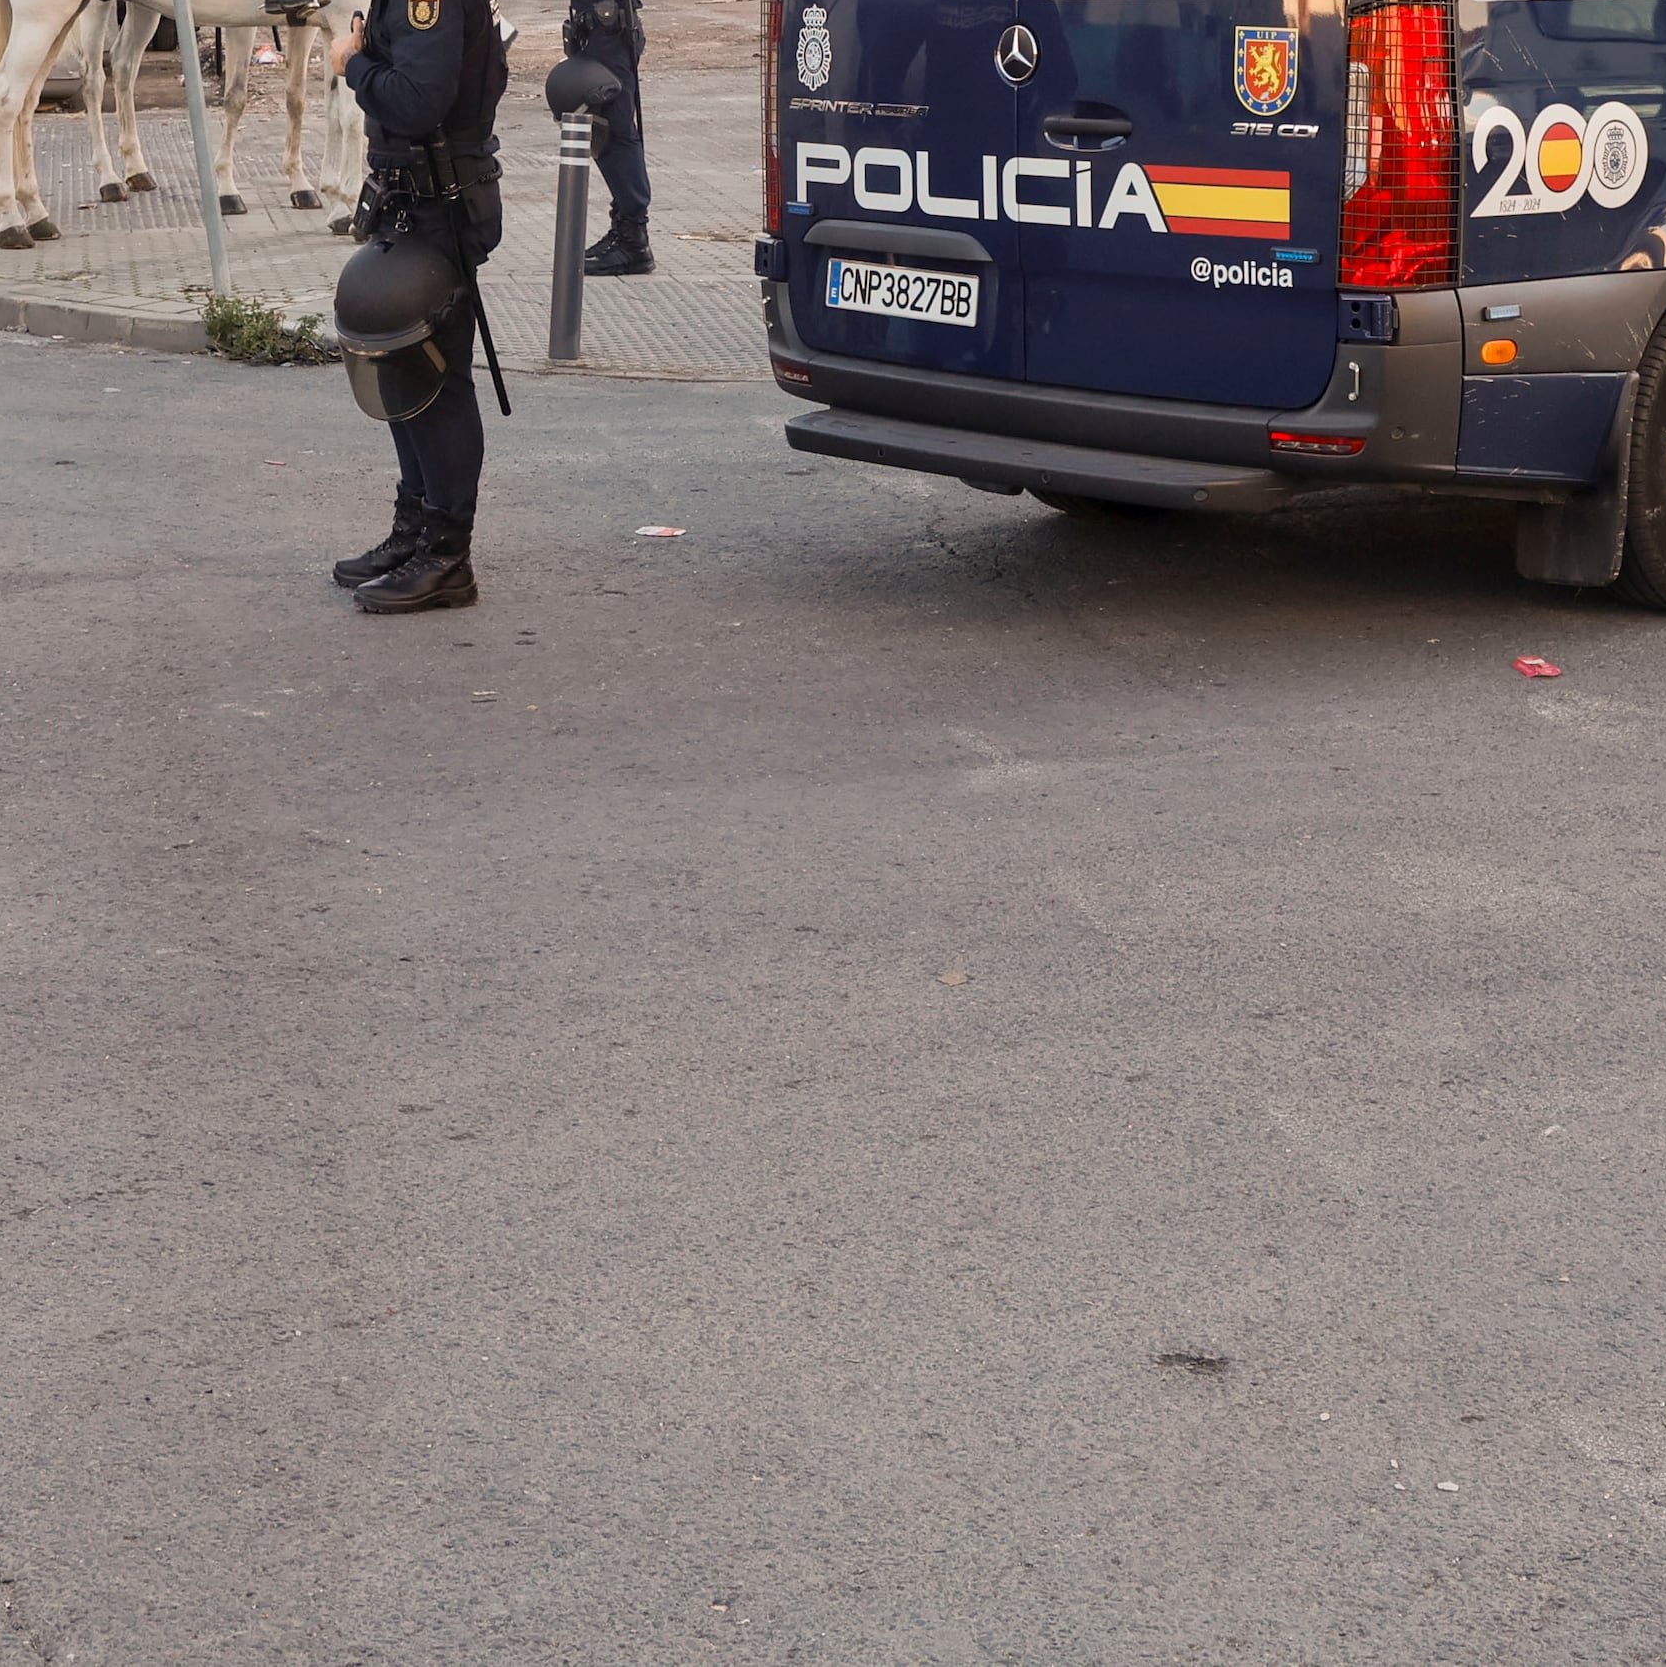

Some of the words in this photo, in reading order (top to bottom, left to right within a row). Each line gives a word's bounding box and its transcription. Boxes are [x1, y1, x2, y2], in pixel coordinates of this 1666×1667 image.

[1256, 31, 1278, 39] UIP
[789, 97, 874, 115] SPRINTER
[1230, 122, 1273, 135] 315
[1276, 123, 1320, 138] CDI
[1190, 256, 1293, 289] @policia
[840, 267, 973, 318] CNP3827BB
